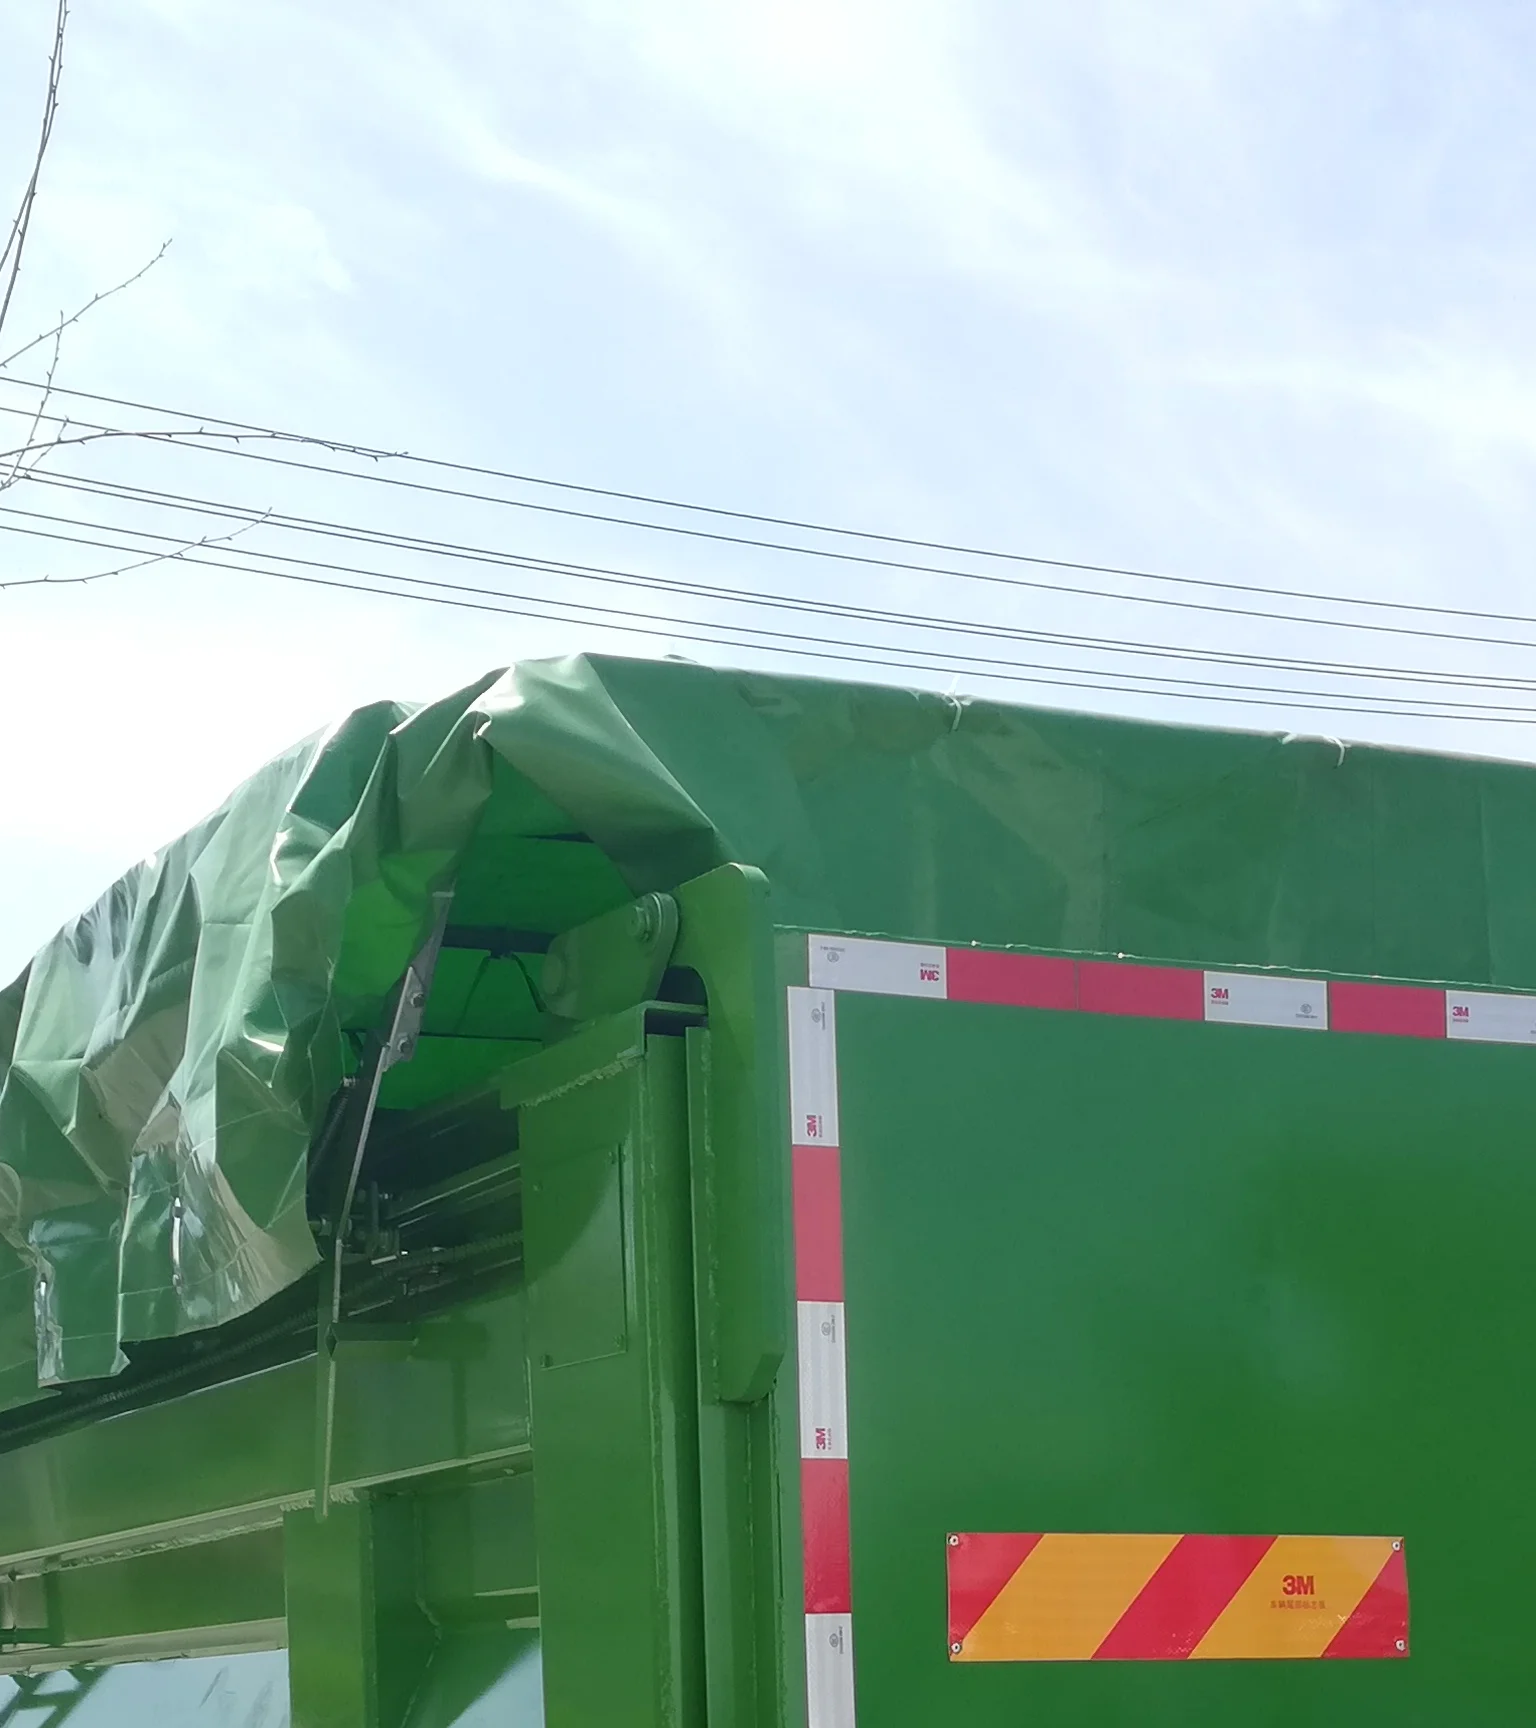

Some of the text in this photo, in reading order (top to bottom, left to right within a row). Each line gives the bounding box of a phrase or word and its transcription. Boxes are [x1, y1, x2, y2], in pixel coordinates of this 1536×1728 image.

[1211, 987, 1229, 1000] 3M
[1452, 1006, 1469, 1017] 3M
[806, 1115, 817, 1138] 3M
[816, 1427, 826, 1450] 3M
[1282, 1574, 1315, 1596] 3M
